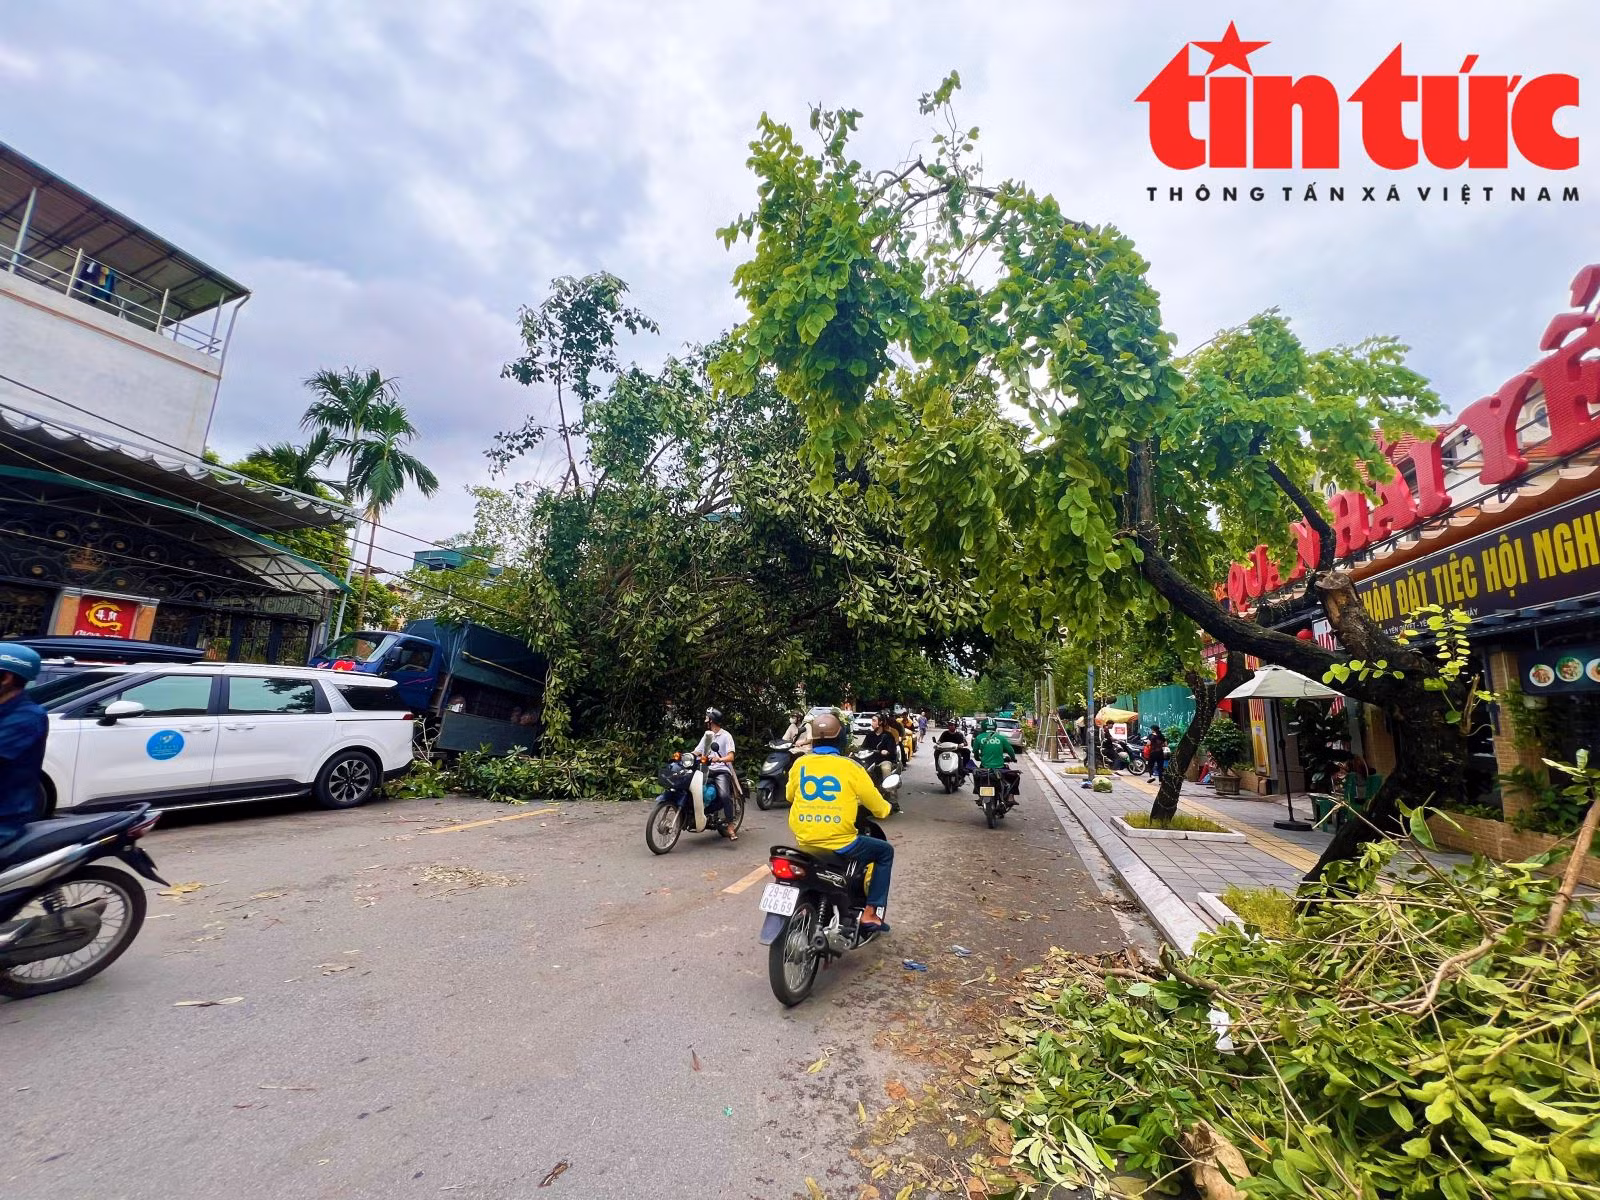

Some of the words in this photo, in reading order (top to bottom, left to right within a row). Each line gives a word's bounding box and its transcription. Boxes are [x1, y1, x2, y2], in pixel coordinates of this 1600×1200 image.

[1358, 581, 1394, 628] HẬN
[1432, 552, 1479, 609] TIỆC
[1481, 533, 1528, 598] HỘI
[800, 765, 842, 802] be
